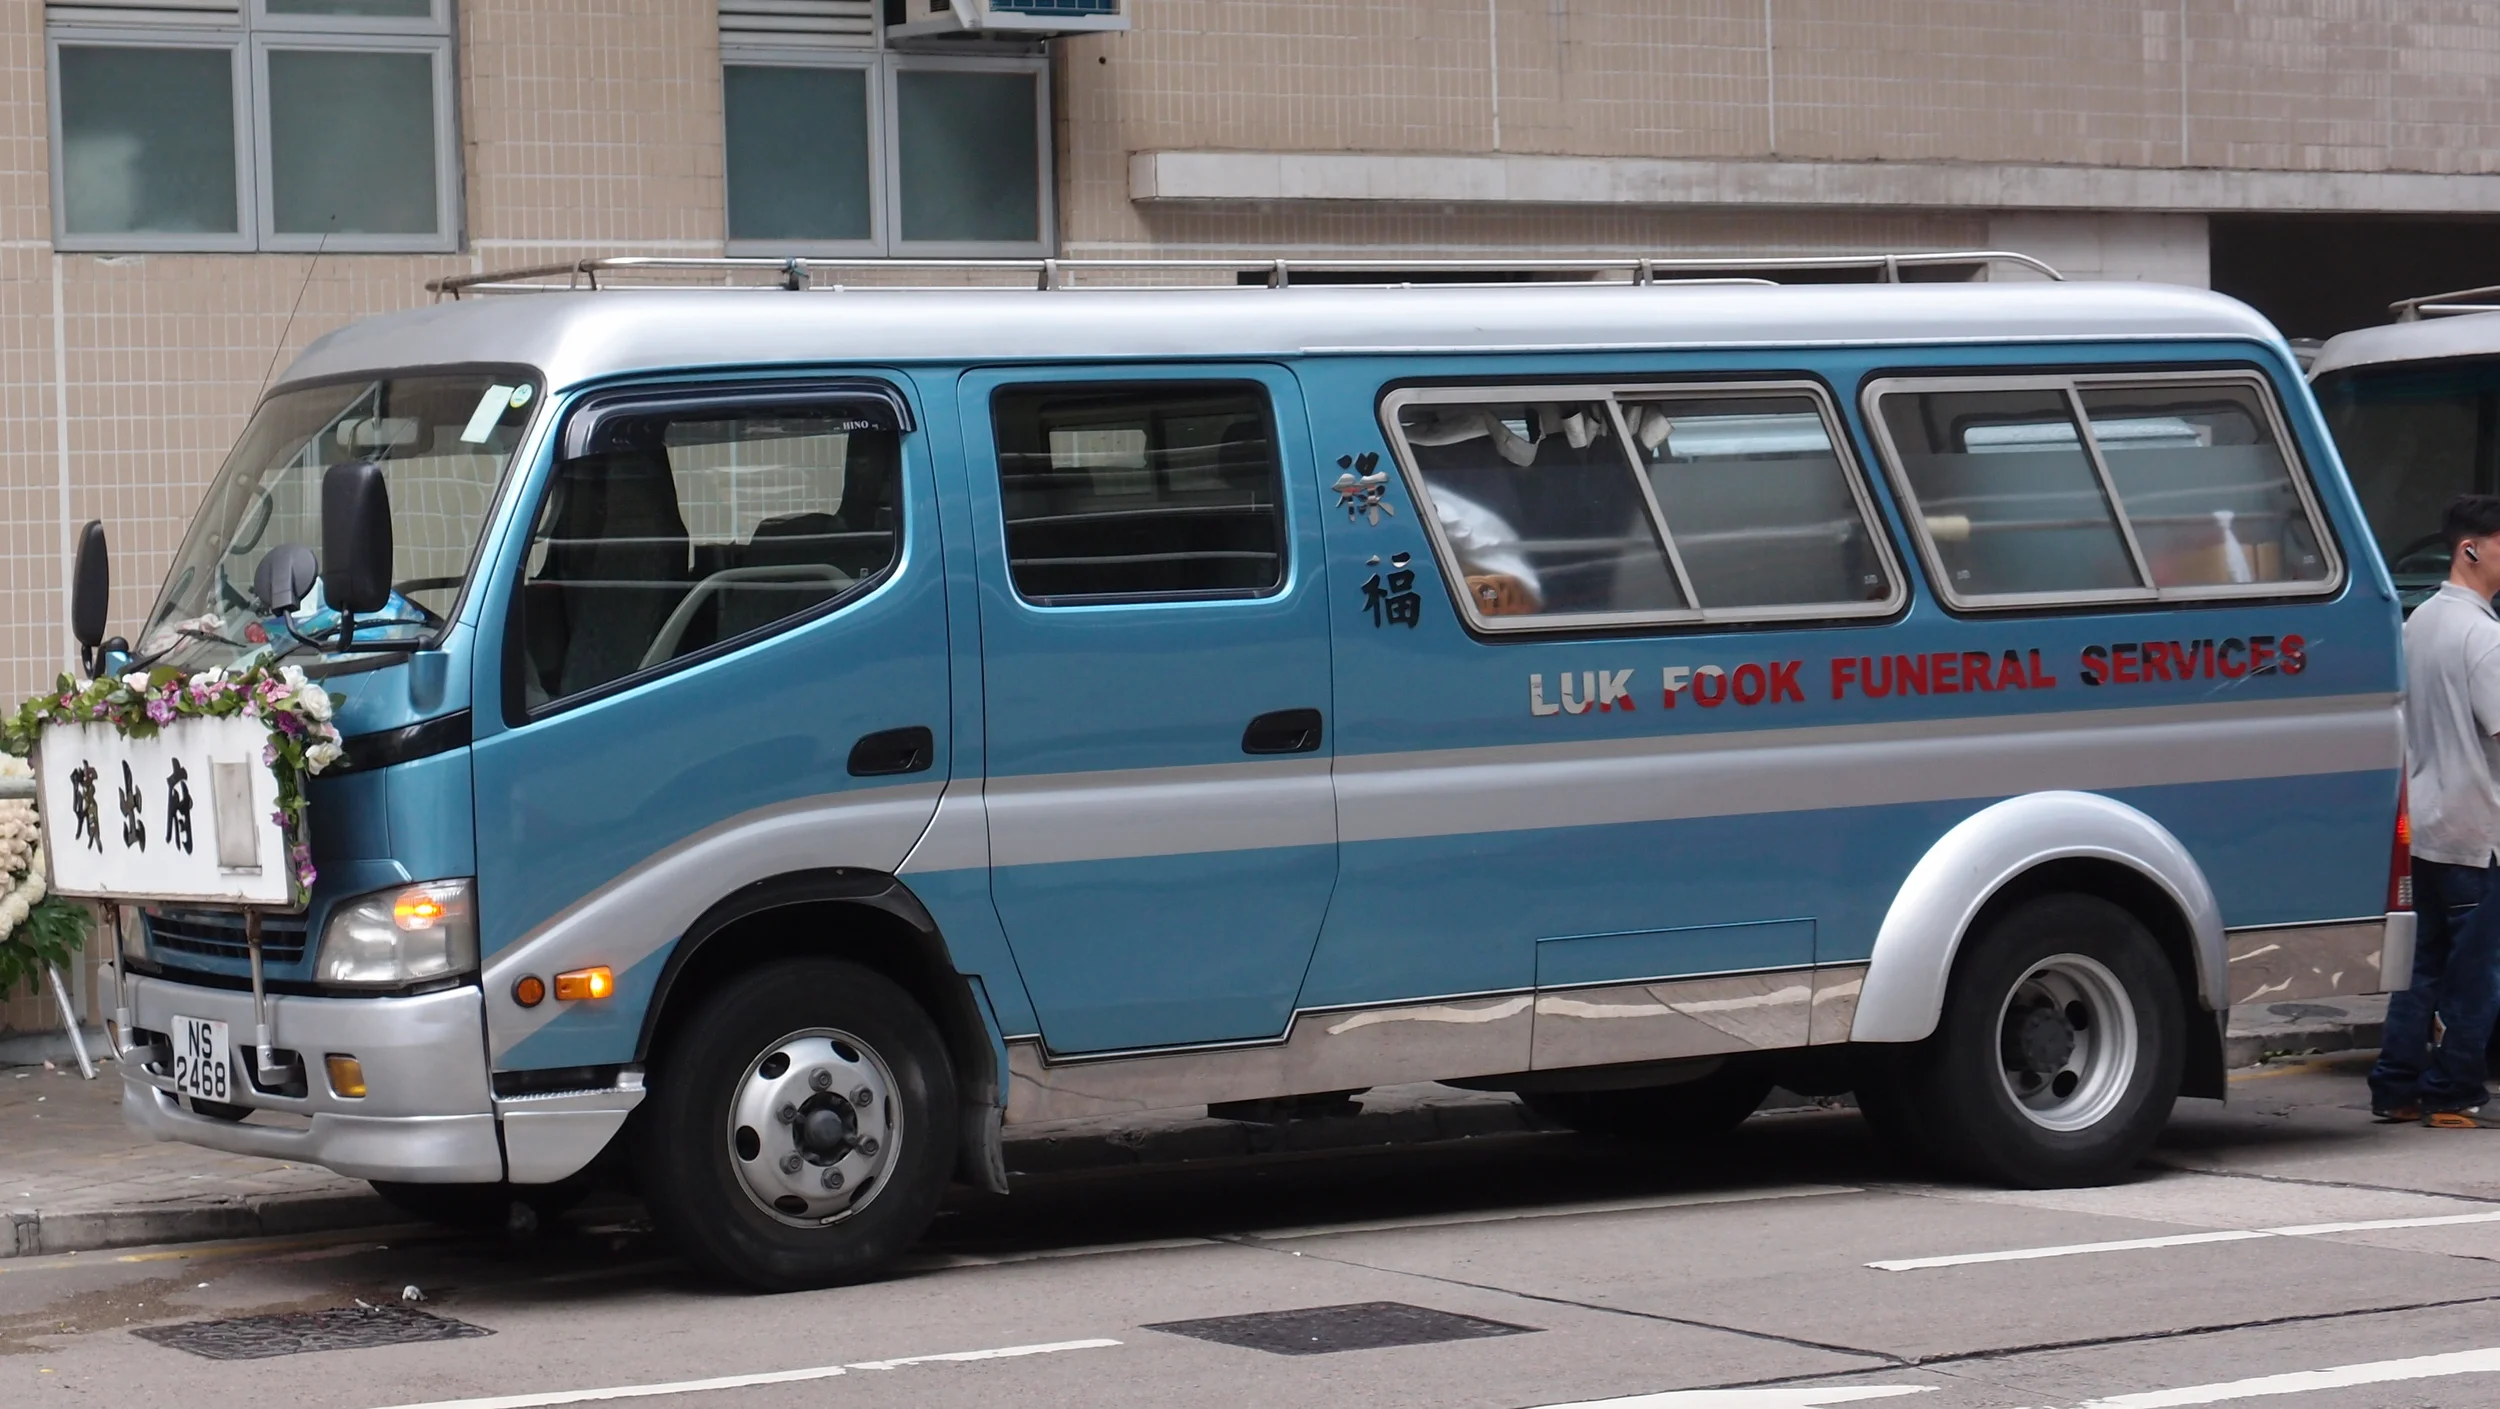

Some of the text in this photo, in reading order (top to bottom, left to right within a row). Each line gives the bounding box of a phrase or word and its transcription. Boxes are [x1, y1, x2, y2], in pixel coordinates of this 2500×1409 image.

[843, 420, 869, 430] HINO
[1529, 634, 2307, 716] LUK FOOK FUNERAL SERVICES
[188, 1020, 212, 1059] NS
[176, 1056, 226, 1098] 2468
